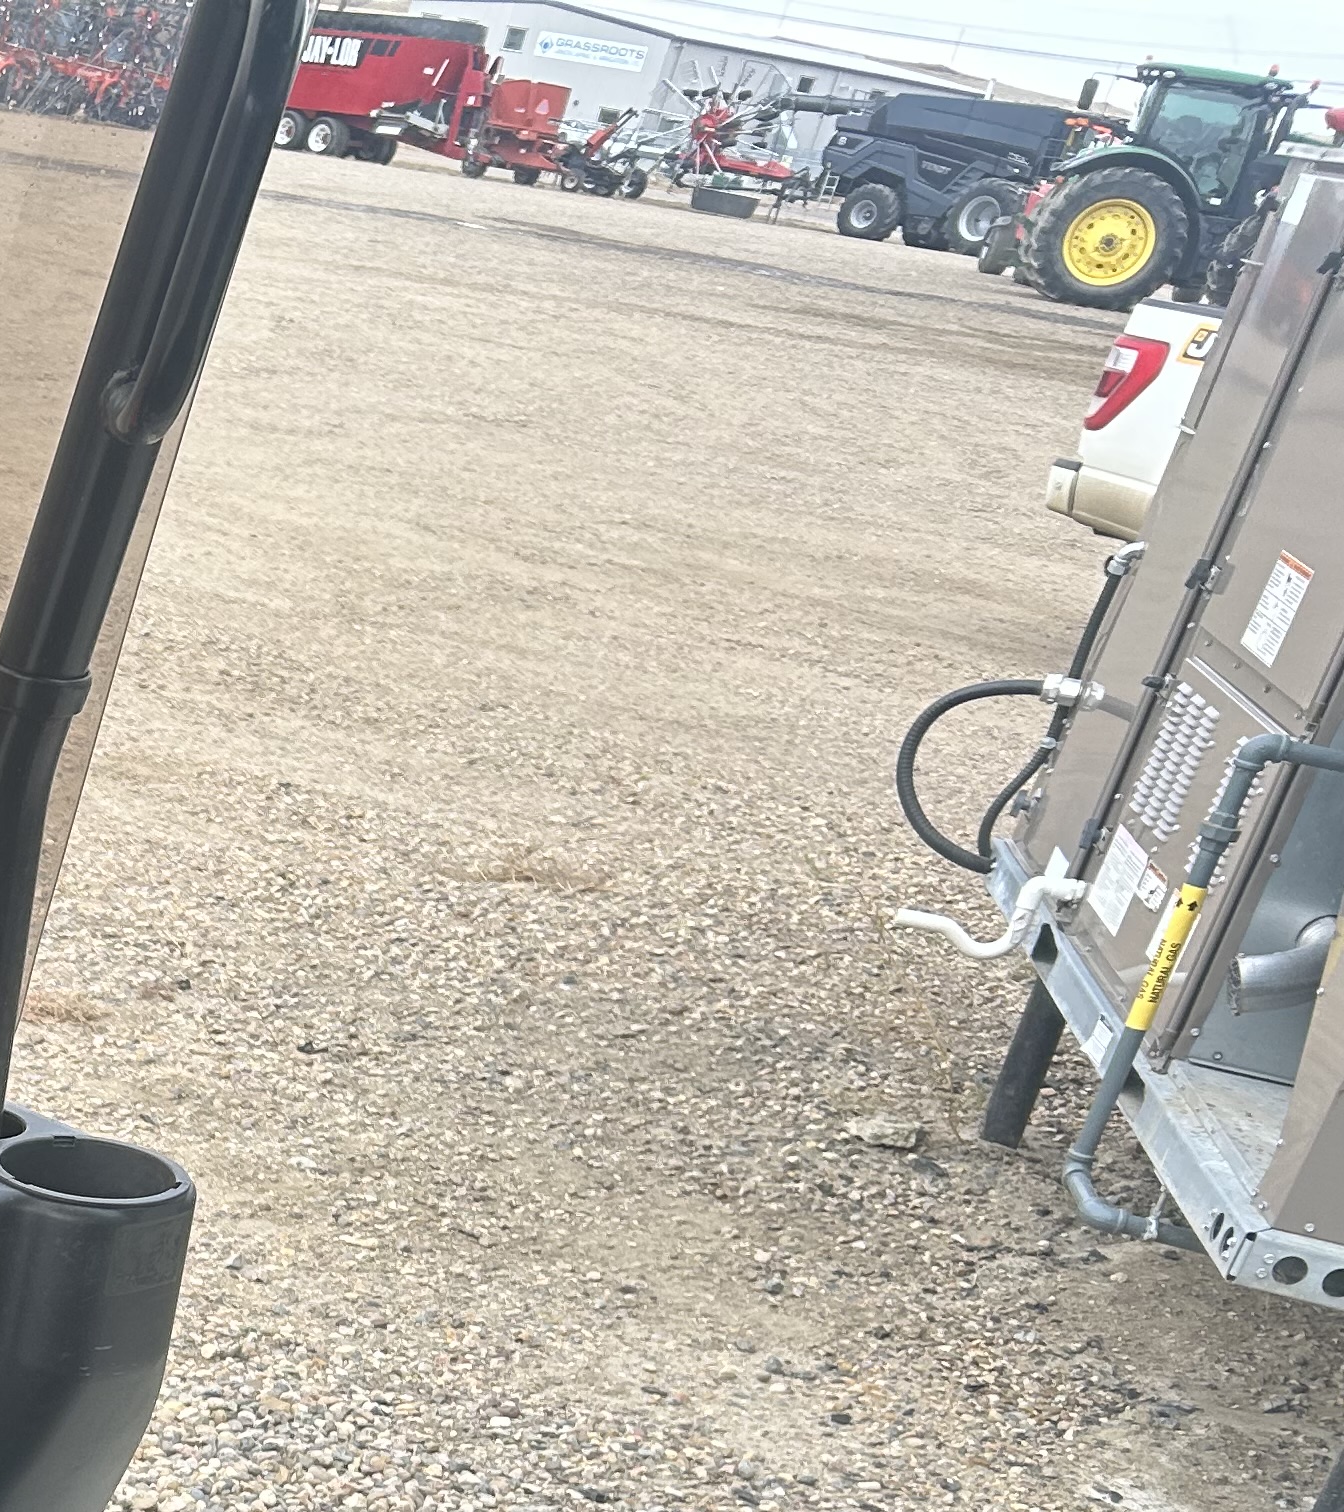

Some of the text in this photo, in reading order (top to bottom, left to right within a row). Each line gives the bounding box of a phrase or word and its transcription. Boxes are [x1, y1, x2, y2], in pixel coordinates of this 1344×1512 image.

[556, 38, 645, 60] GRASSROOTS
[1147, 938, 1167, 976] NATURAL
[1147, 943, 1182, 1004] NATURAL GAS
